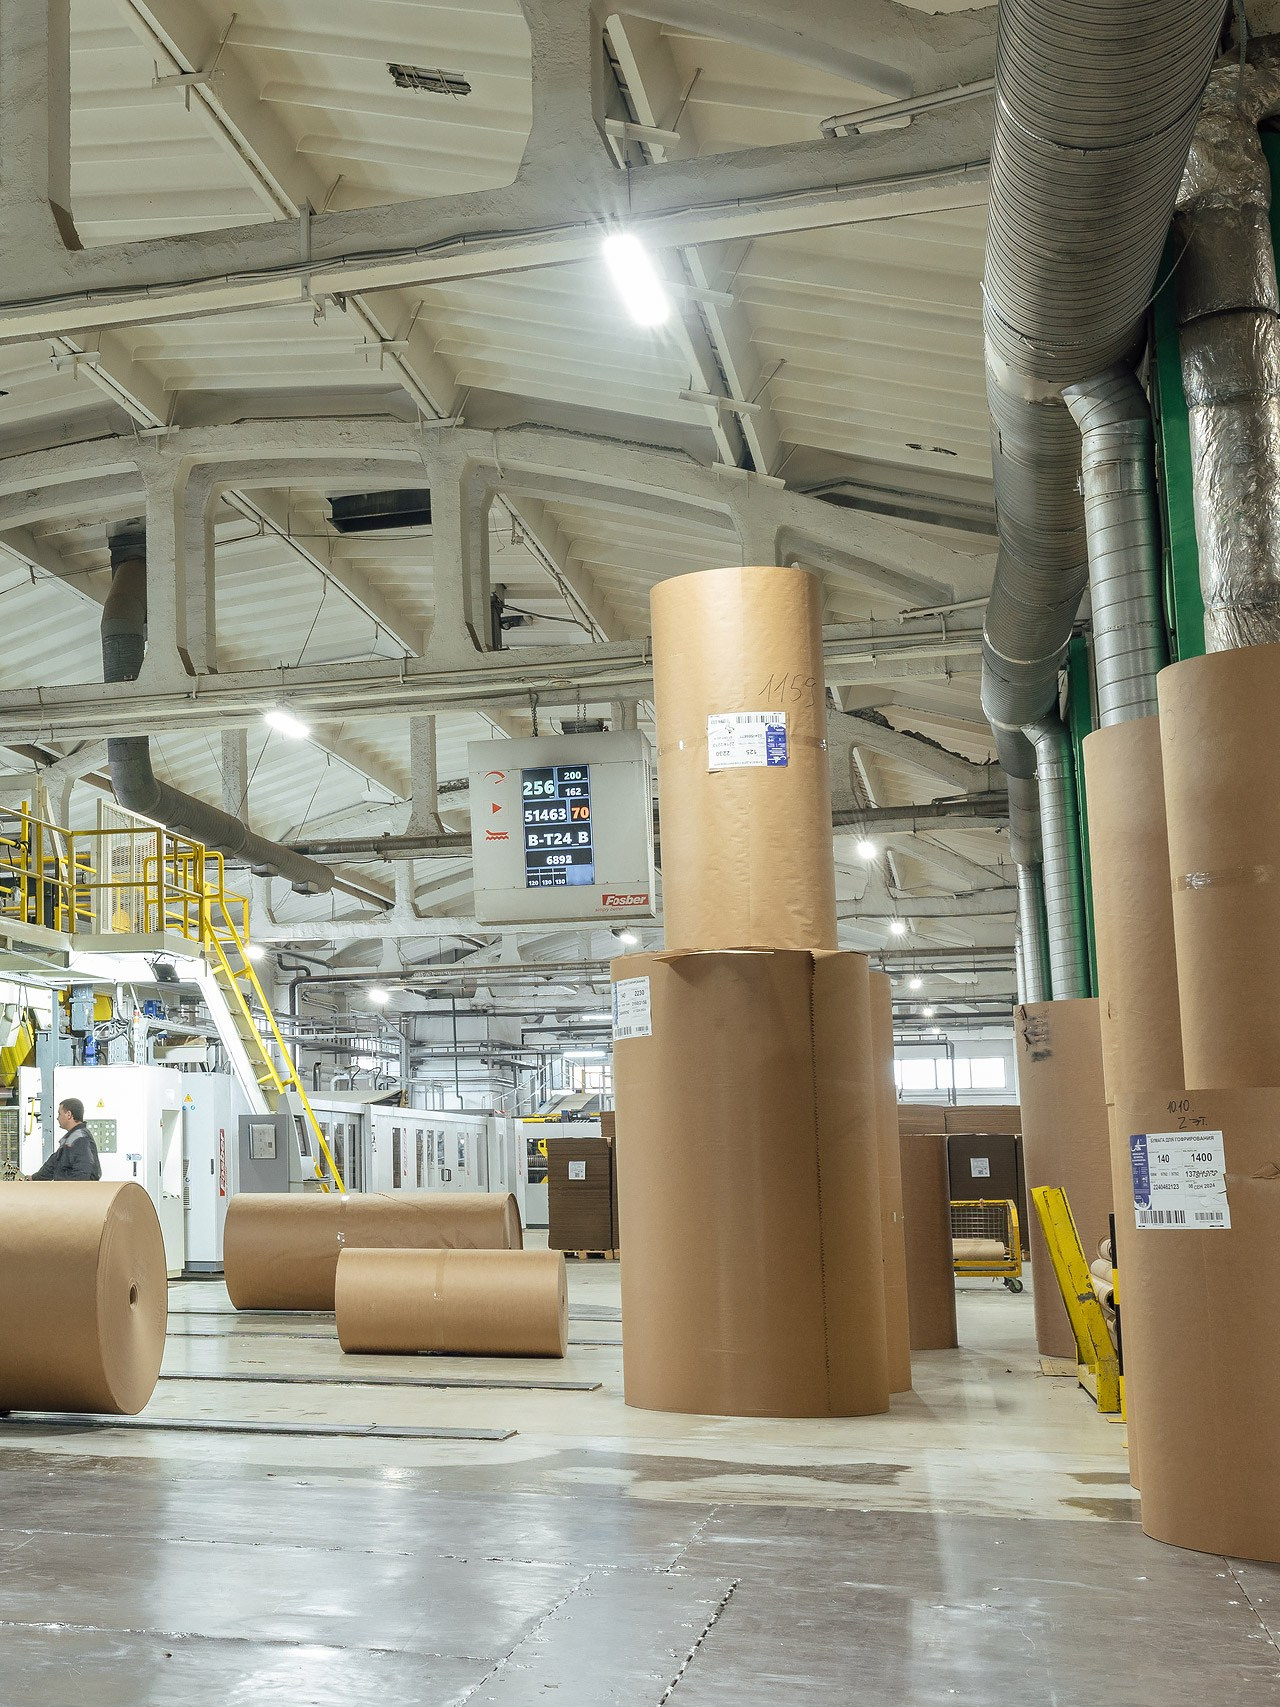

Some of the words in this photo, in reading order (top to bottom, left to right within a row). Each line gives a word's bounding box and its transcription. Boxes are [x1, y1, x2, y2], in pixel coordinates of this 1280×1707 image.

[564, 771, 582, 780] 200
[522, 779, 555, 796] 256
[565, 787, 582, 796] 162
[524, 808, 567, 822] 51463
[571, 806, 589, 819] 70
[528, 831, 589, 847] B-T24_B
[546, 854, 573, 865] 6892
[605, 893, 647, 906] Fosber
[1157, 1154, 1170, 1163] 140
[1190, 1152, 1213, 1162] 1400
